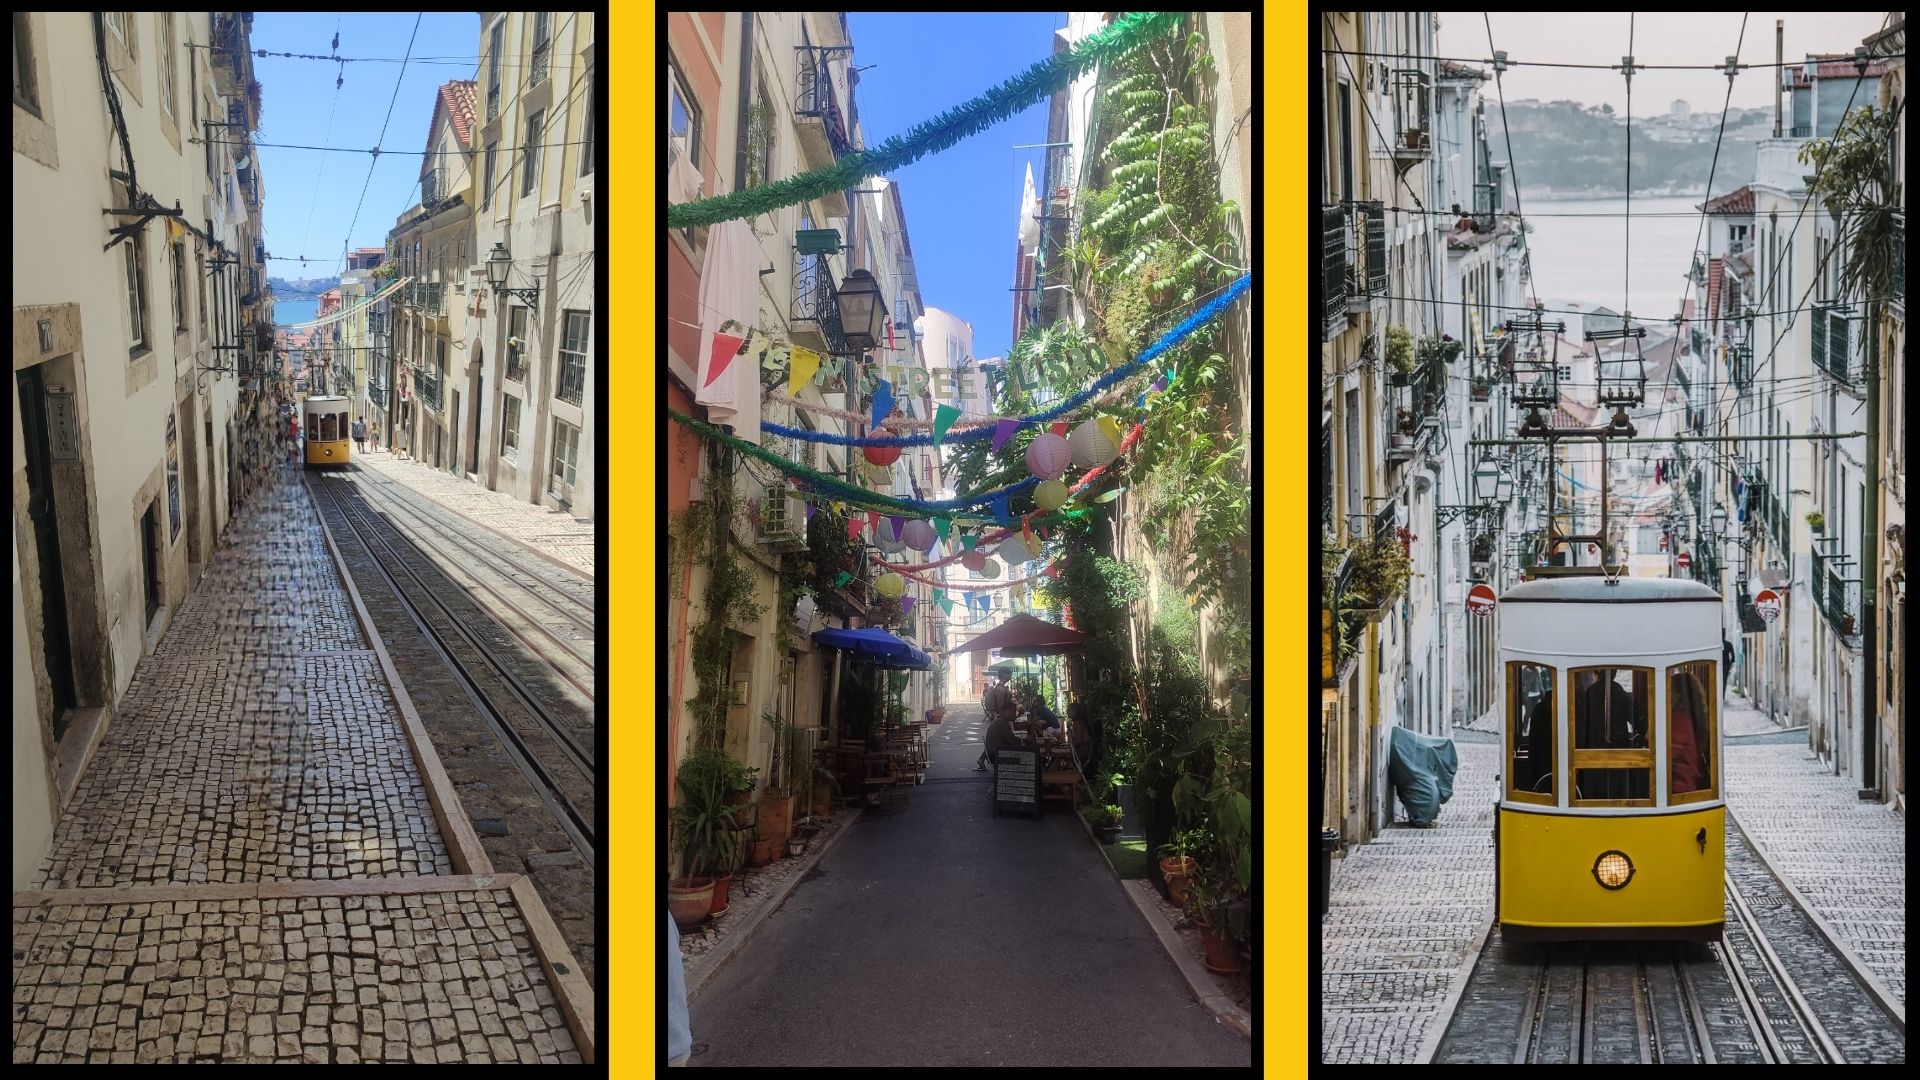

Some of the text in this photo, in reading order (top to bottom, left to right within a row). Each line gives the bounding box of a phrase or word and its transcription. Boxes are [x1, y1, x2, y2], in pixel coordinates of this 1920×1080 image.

[719, 319, 1131, 400] REN STREET LISBON
